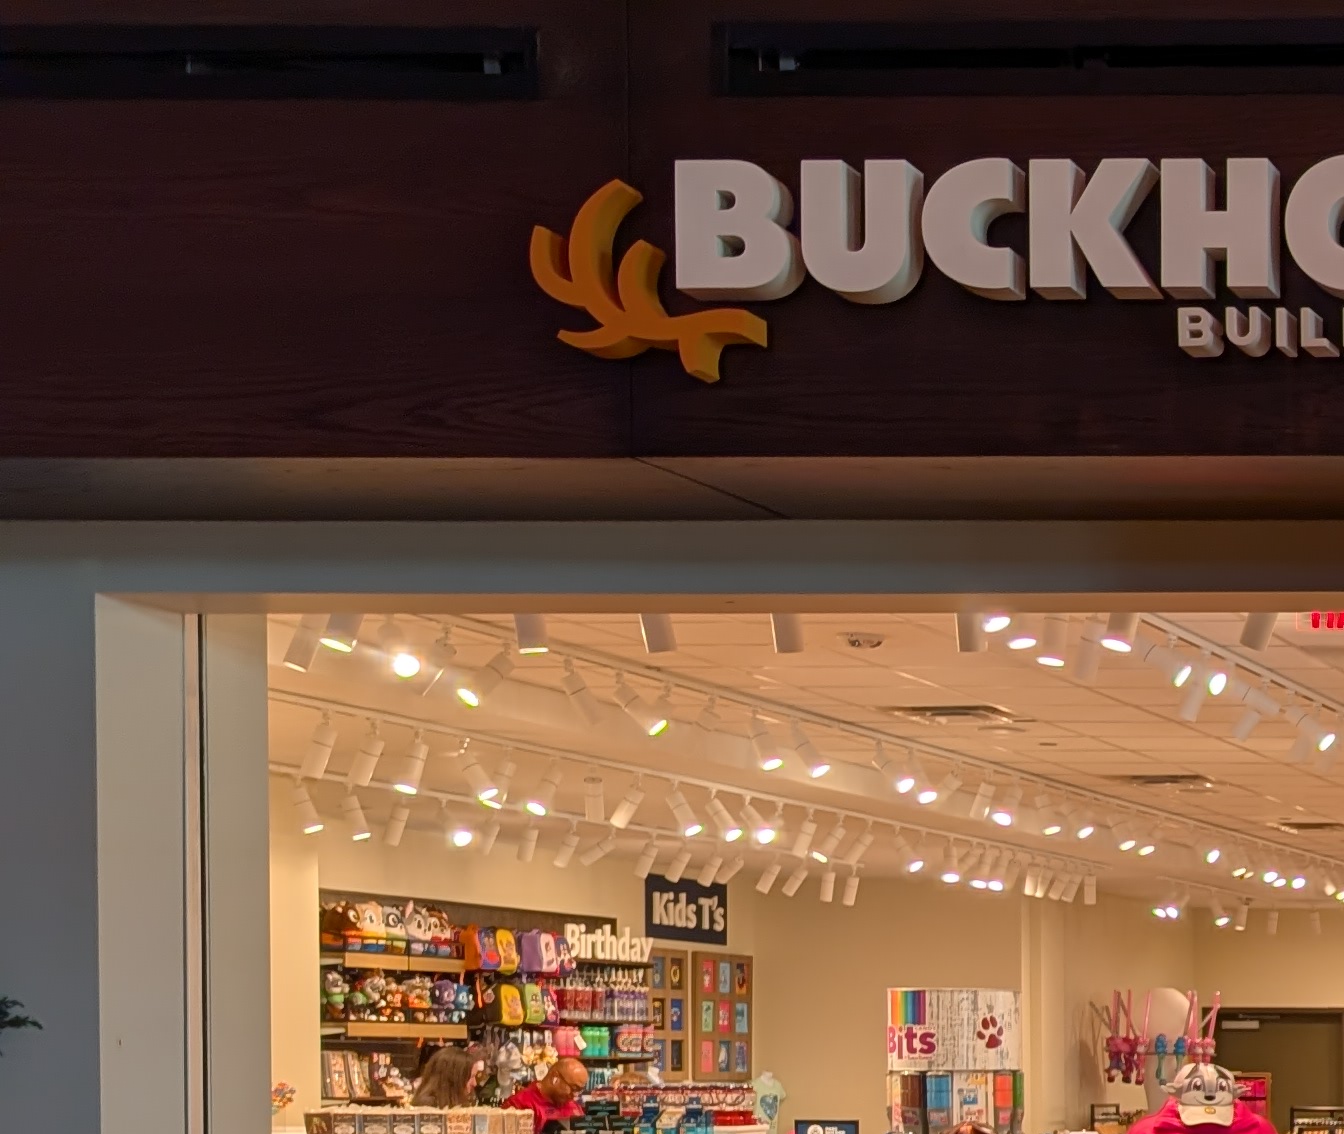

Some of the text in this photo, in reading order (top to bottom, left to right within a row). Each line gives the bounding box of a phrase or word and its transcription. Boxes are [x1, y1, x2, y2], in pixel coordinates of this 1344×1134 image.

[652, 891, 725, 932] Kids T's
[564, 922, 654, 963] Birthday
